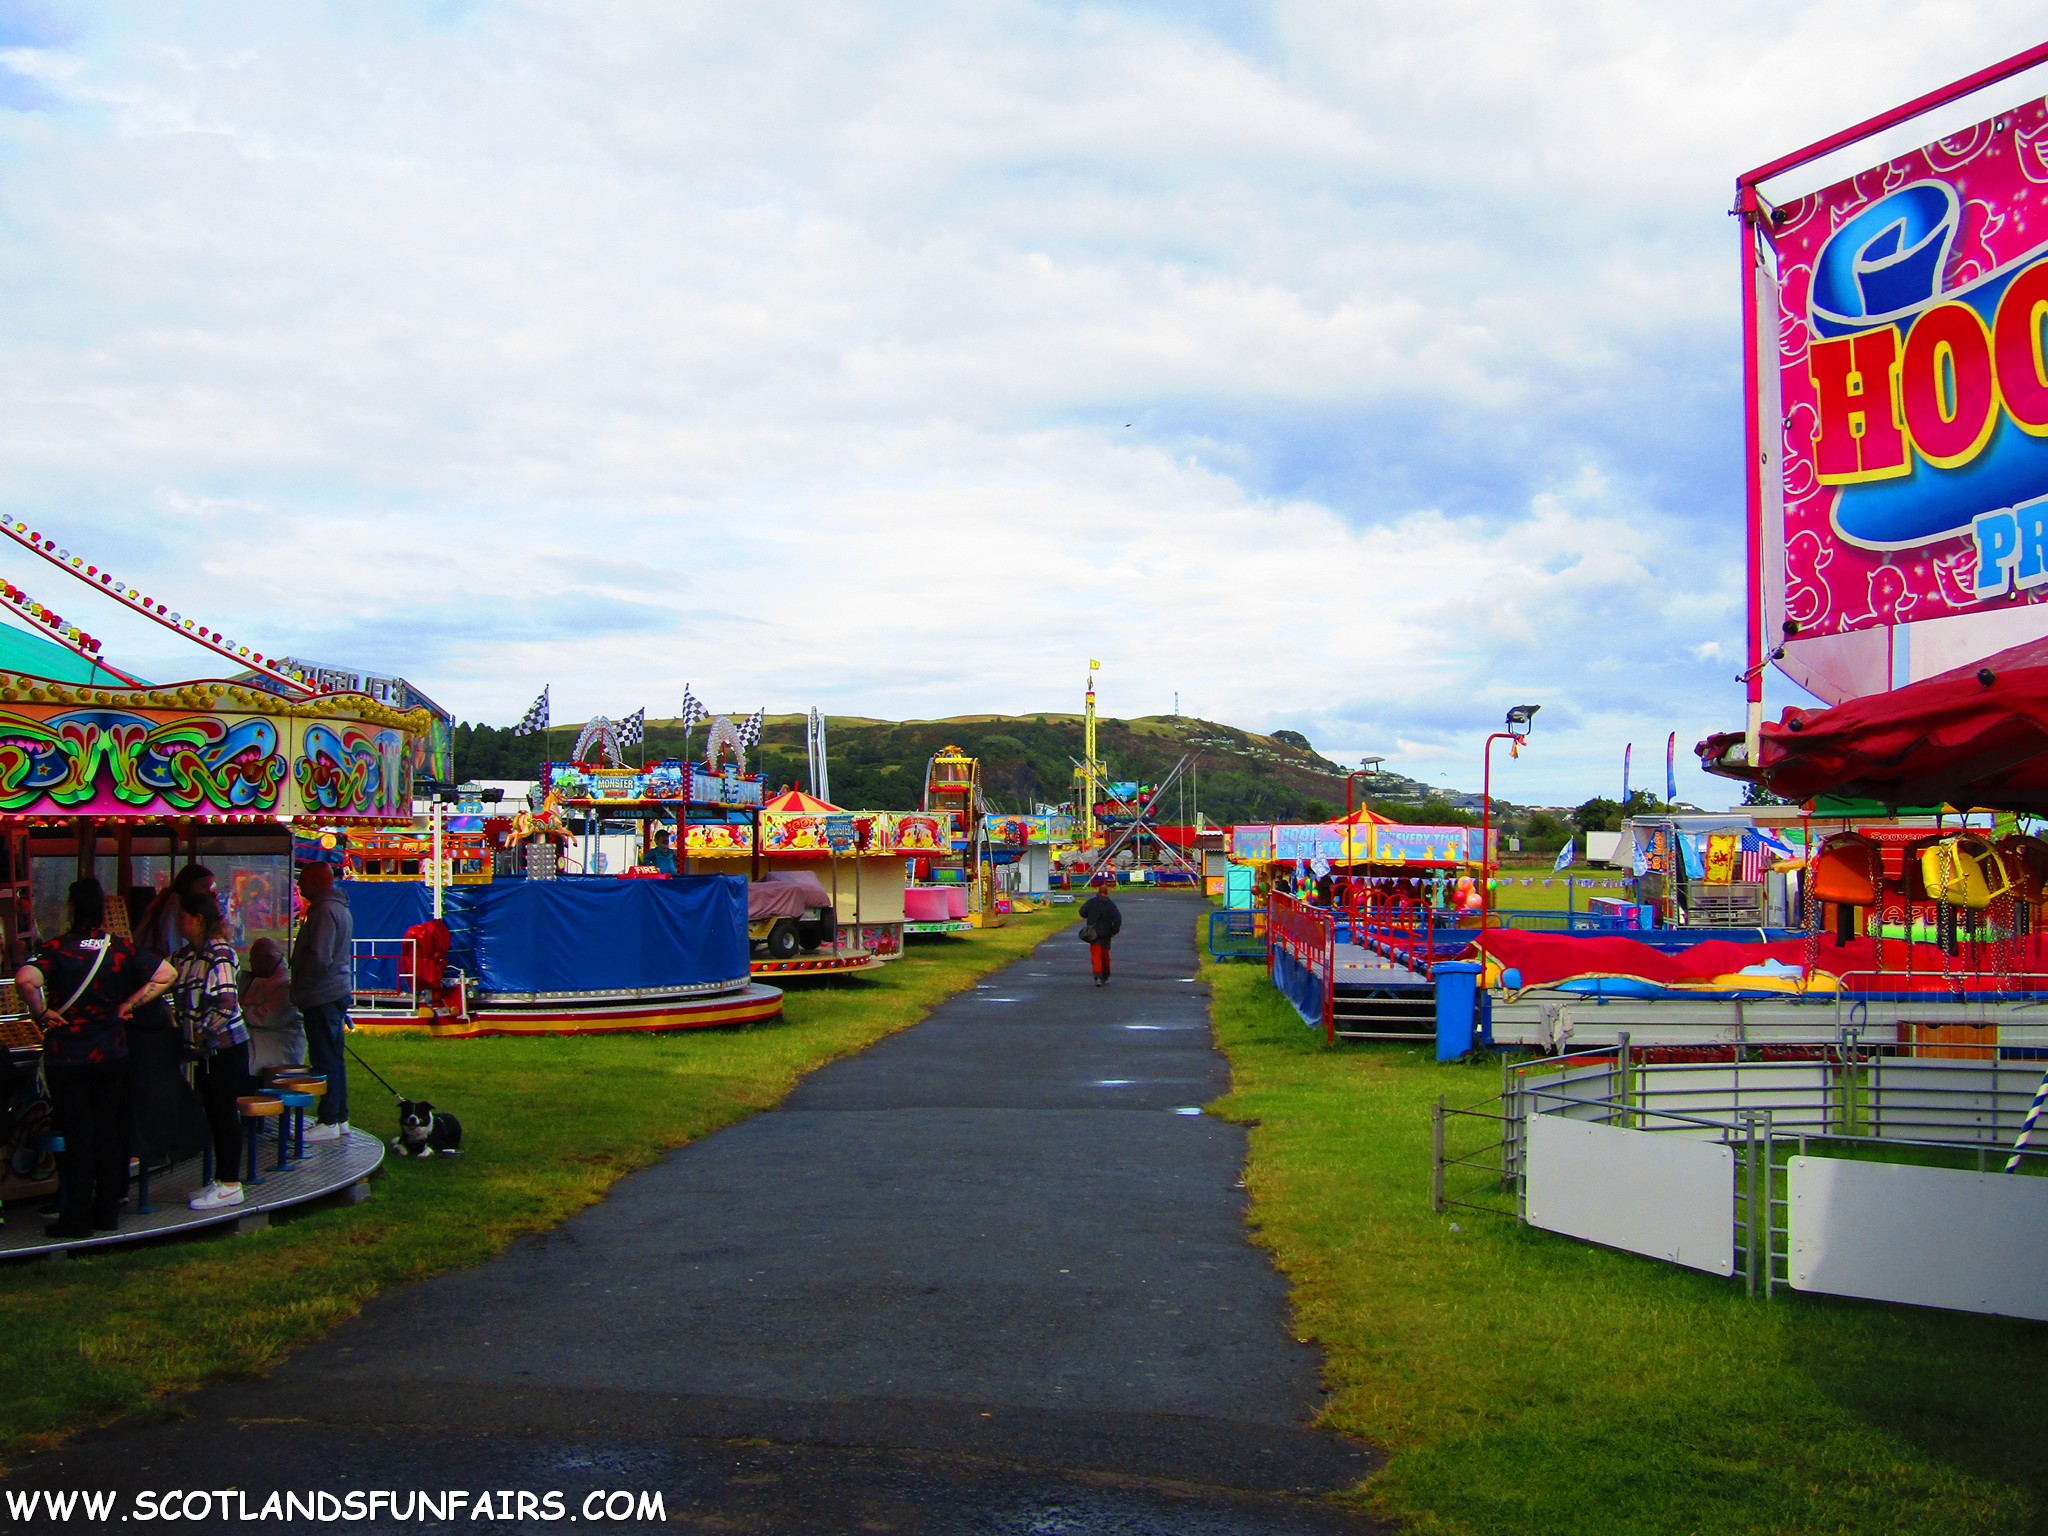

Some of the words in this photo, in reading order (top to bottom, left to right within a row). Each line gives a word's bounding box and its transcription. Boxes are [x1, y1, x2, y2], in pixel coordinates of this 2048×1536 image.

[1973, 502, 2048, 600] PR
[458, 784, 480, 792] TURBO
[598, 778, 634, 789] MONSTER
[1281, 827, 1320, 839] HOOK
[1395, 832, 1430, 841] EVERY
[1434, 833, 1460, 842] TIME
[1300, 841, 1339, 853] DCK
[635, 866, 657, 875] FIRE
